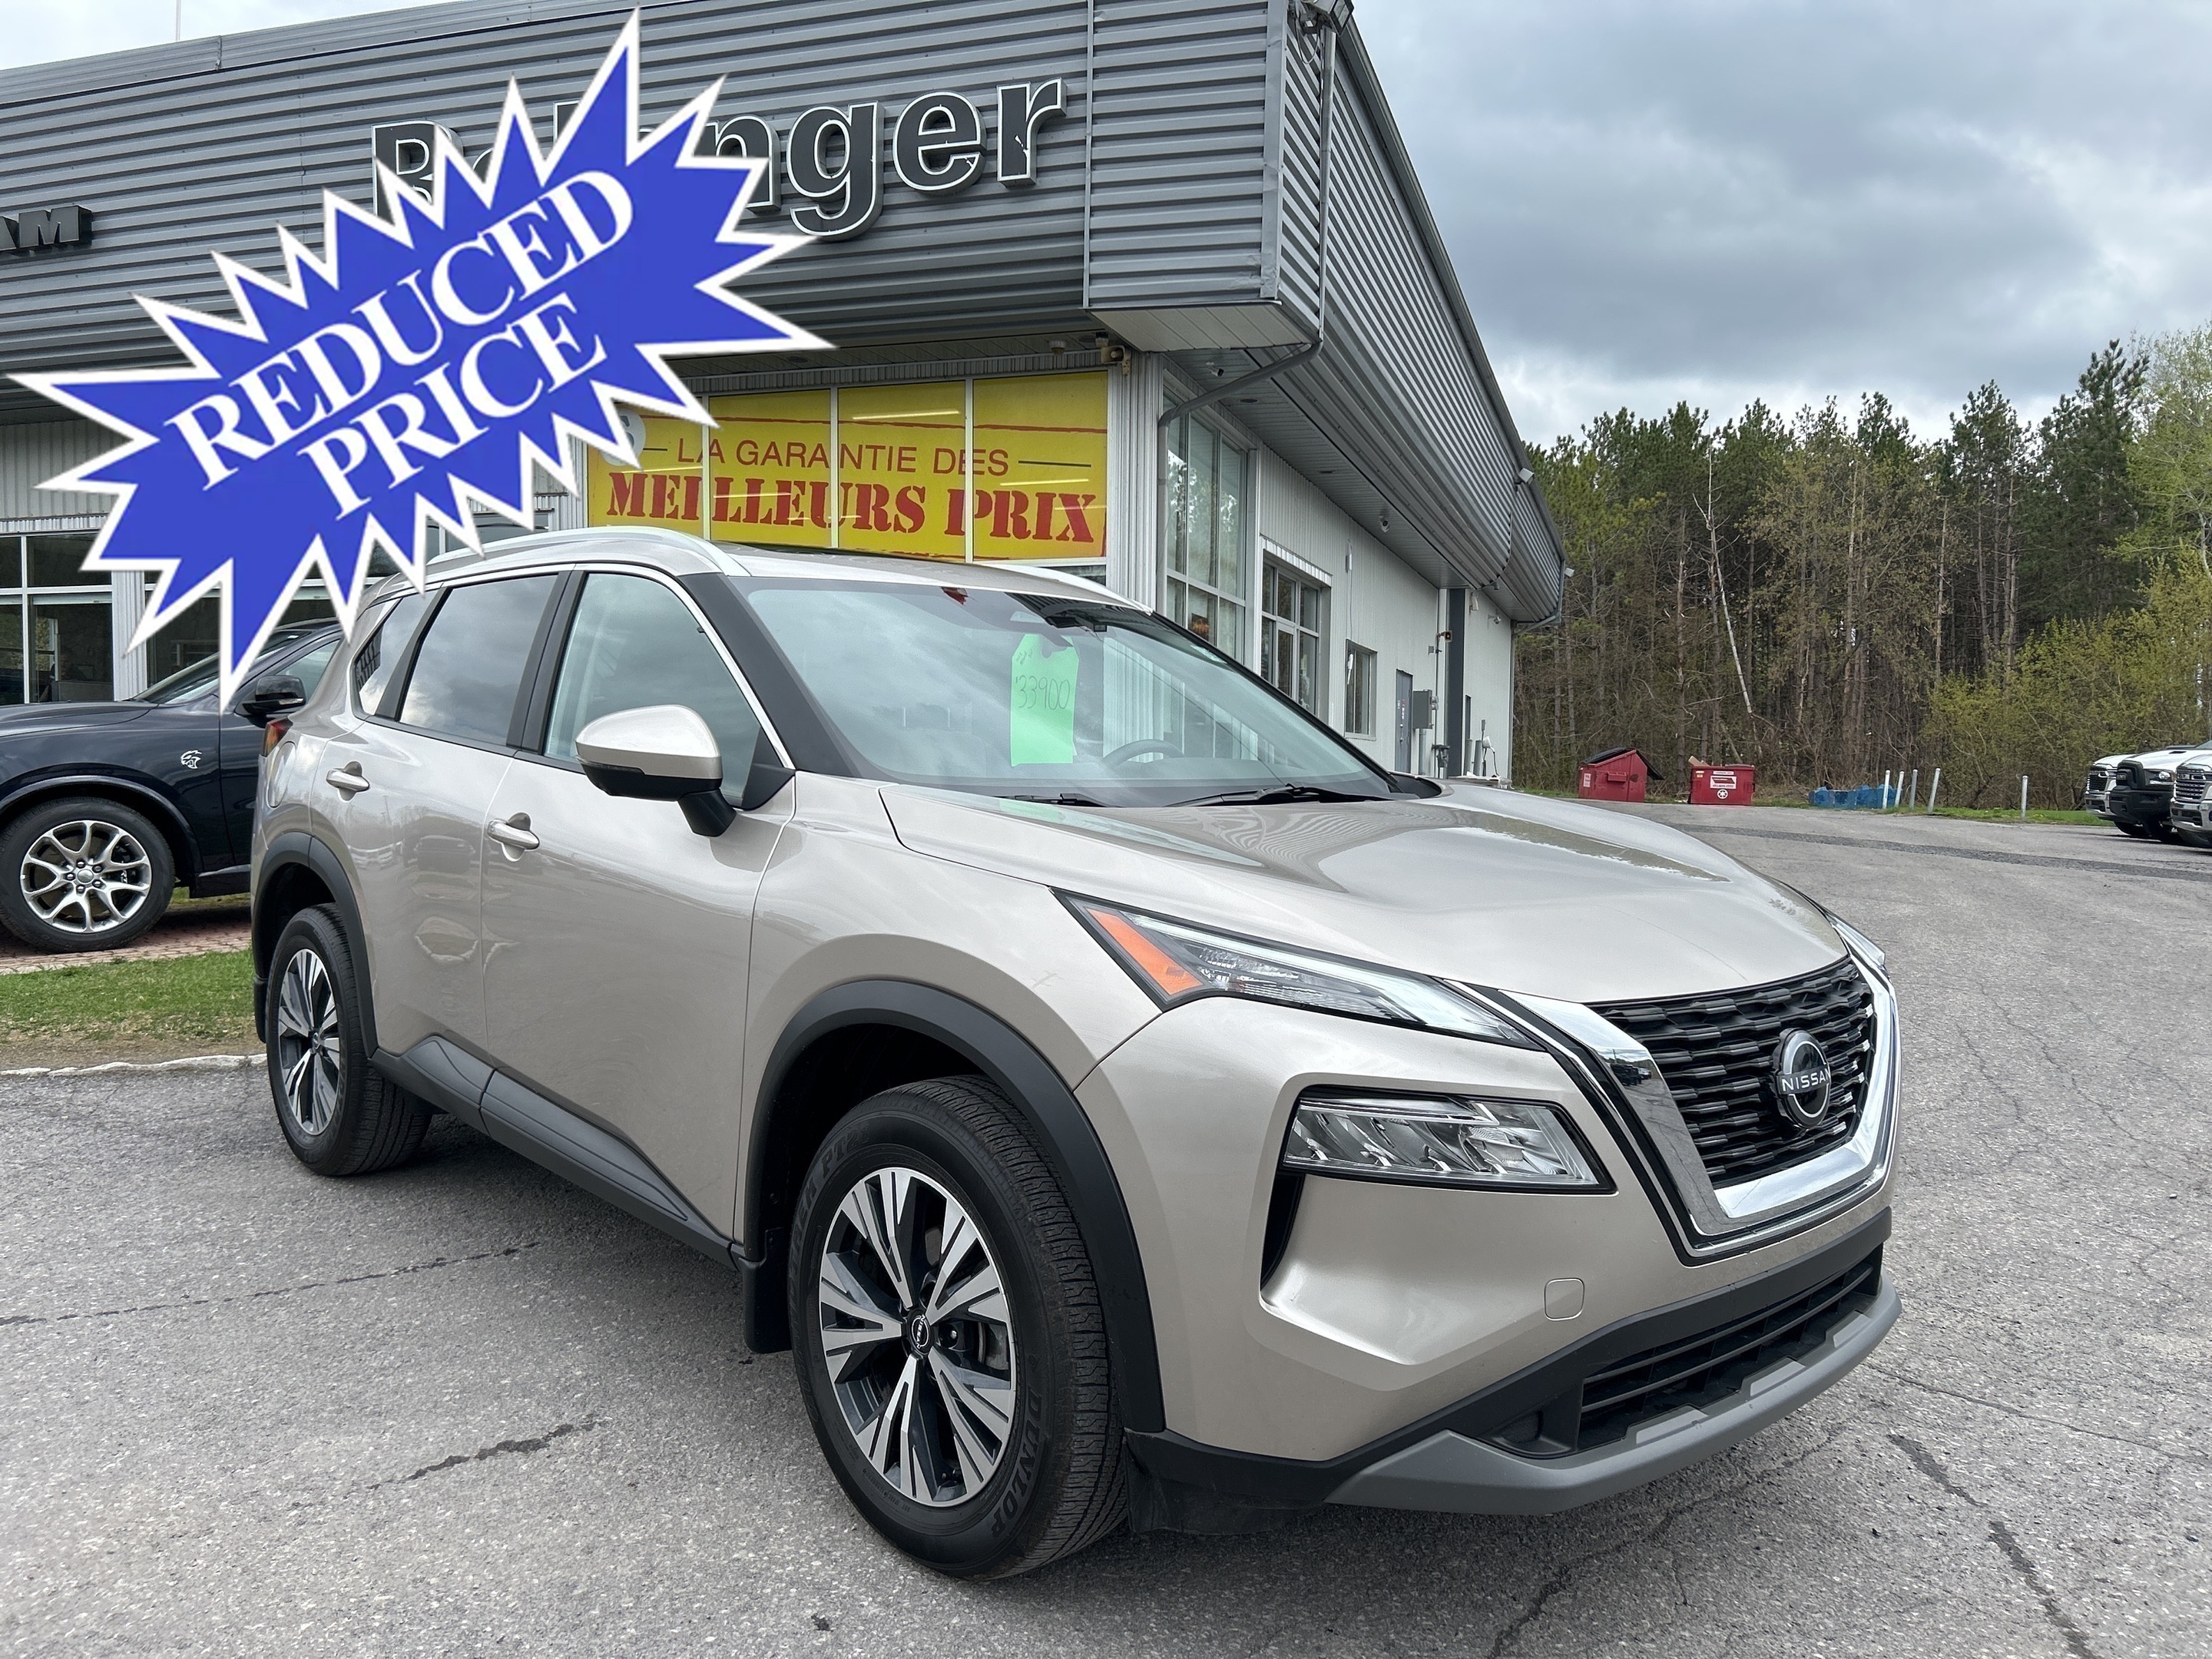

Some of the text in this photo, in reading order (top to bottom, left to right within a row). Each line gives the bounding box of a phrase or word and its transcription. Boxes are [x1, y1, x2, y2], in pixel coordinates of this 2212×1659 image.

[677, 438, 1009, 477] LA GARANTIE DES
[607, 472, 1097, 544] MEILLEURS PRIX
[1781, 1068, 1831, 1091] NISSAN
[991, 1384, 1042, 1538] DUNLOP
